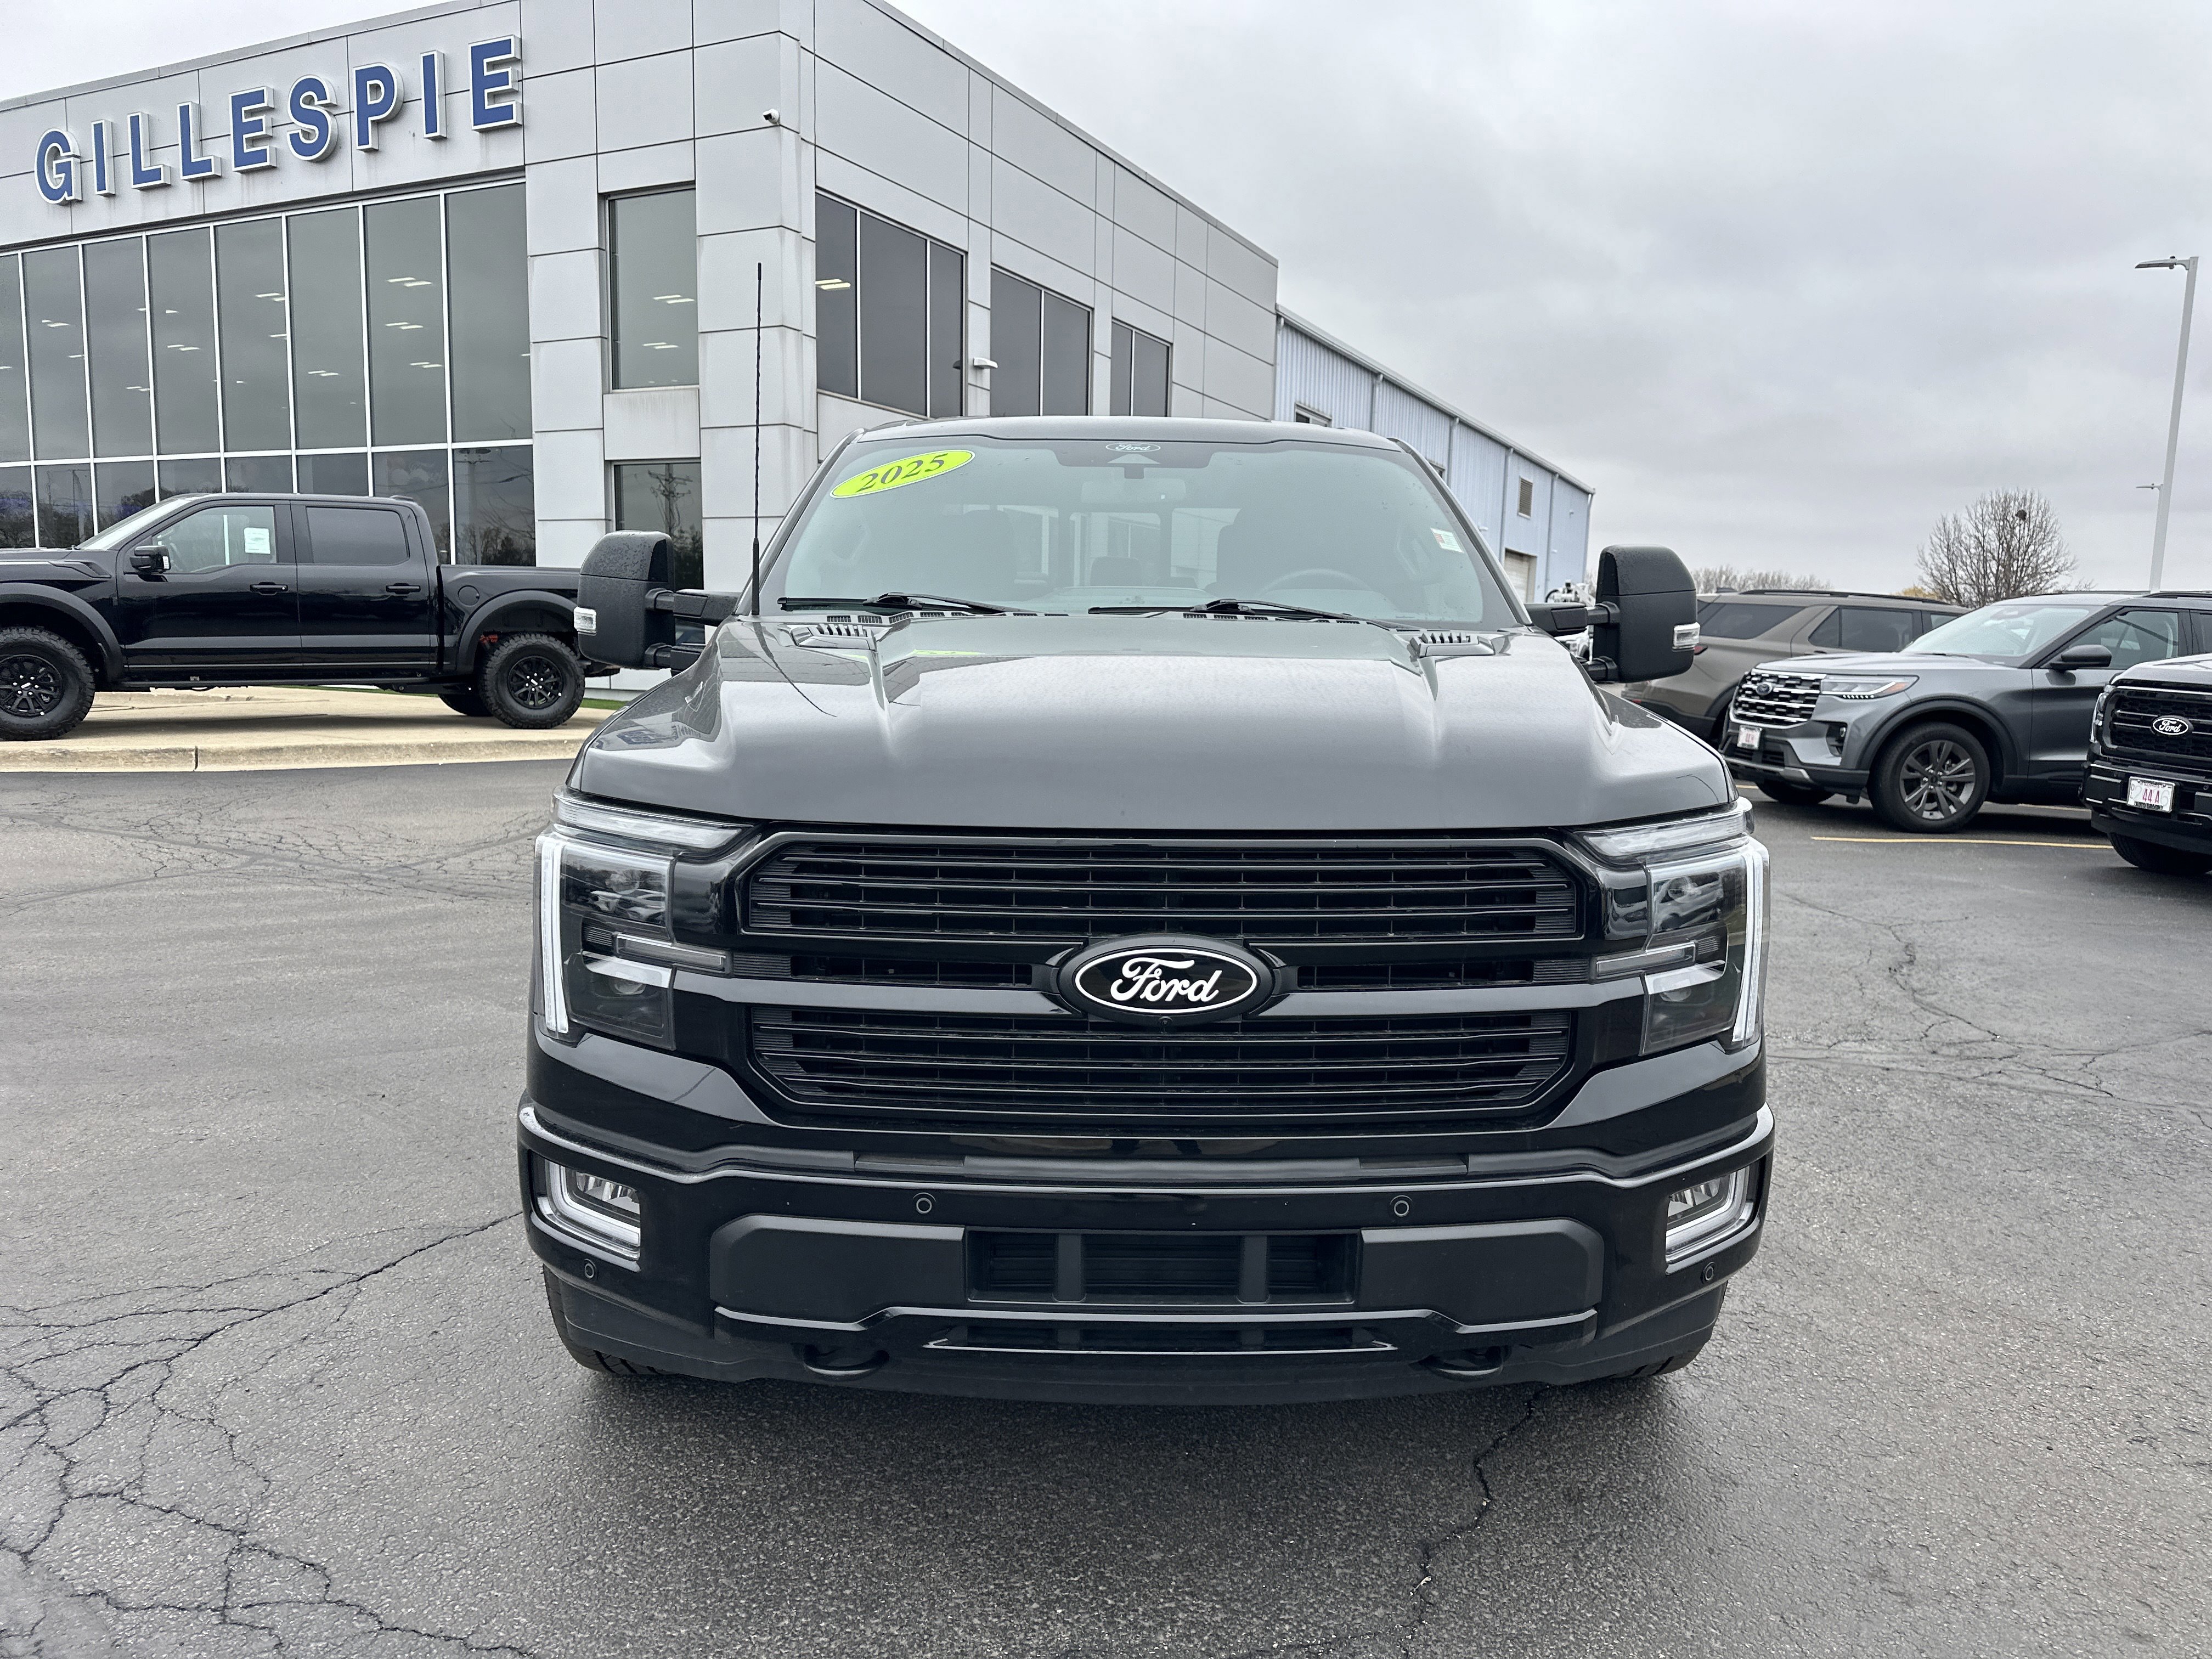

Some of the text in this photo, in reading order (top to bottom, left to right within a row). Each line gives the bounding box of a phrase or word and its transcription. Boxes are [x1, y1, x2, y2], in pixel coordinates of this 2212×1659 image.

[34, 35, 522, 205] GILLESPIE
[855, 453, 948, 493] 2025
[2159, 719, 2182, 732] Ford
[1110, 957, 1223, 1002] Ford
